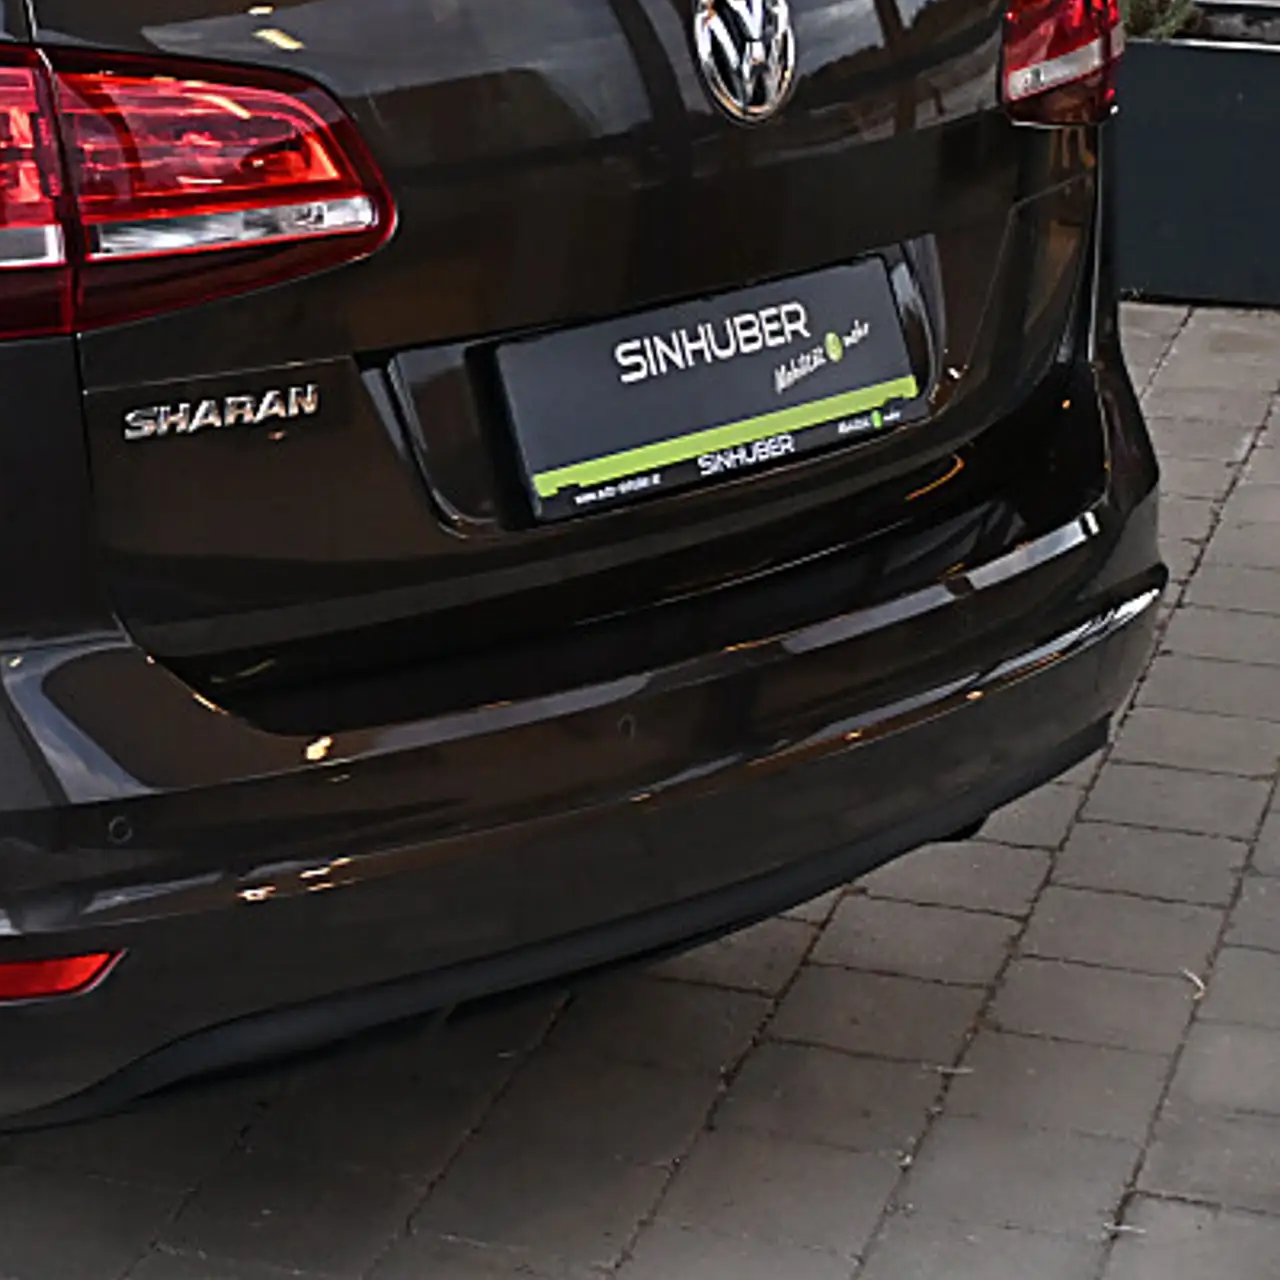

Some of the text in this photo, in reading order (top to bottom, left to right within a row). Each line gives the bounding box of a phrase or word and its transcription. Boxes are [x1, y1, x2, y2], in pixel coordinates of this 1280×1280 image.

[614, 301, 811, 384] SINHUBER
[124, 384, 318, 440] SHARAN
[697, 434, 795, 477] SINHUBER
